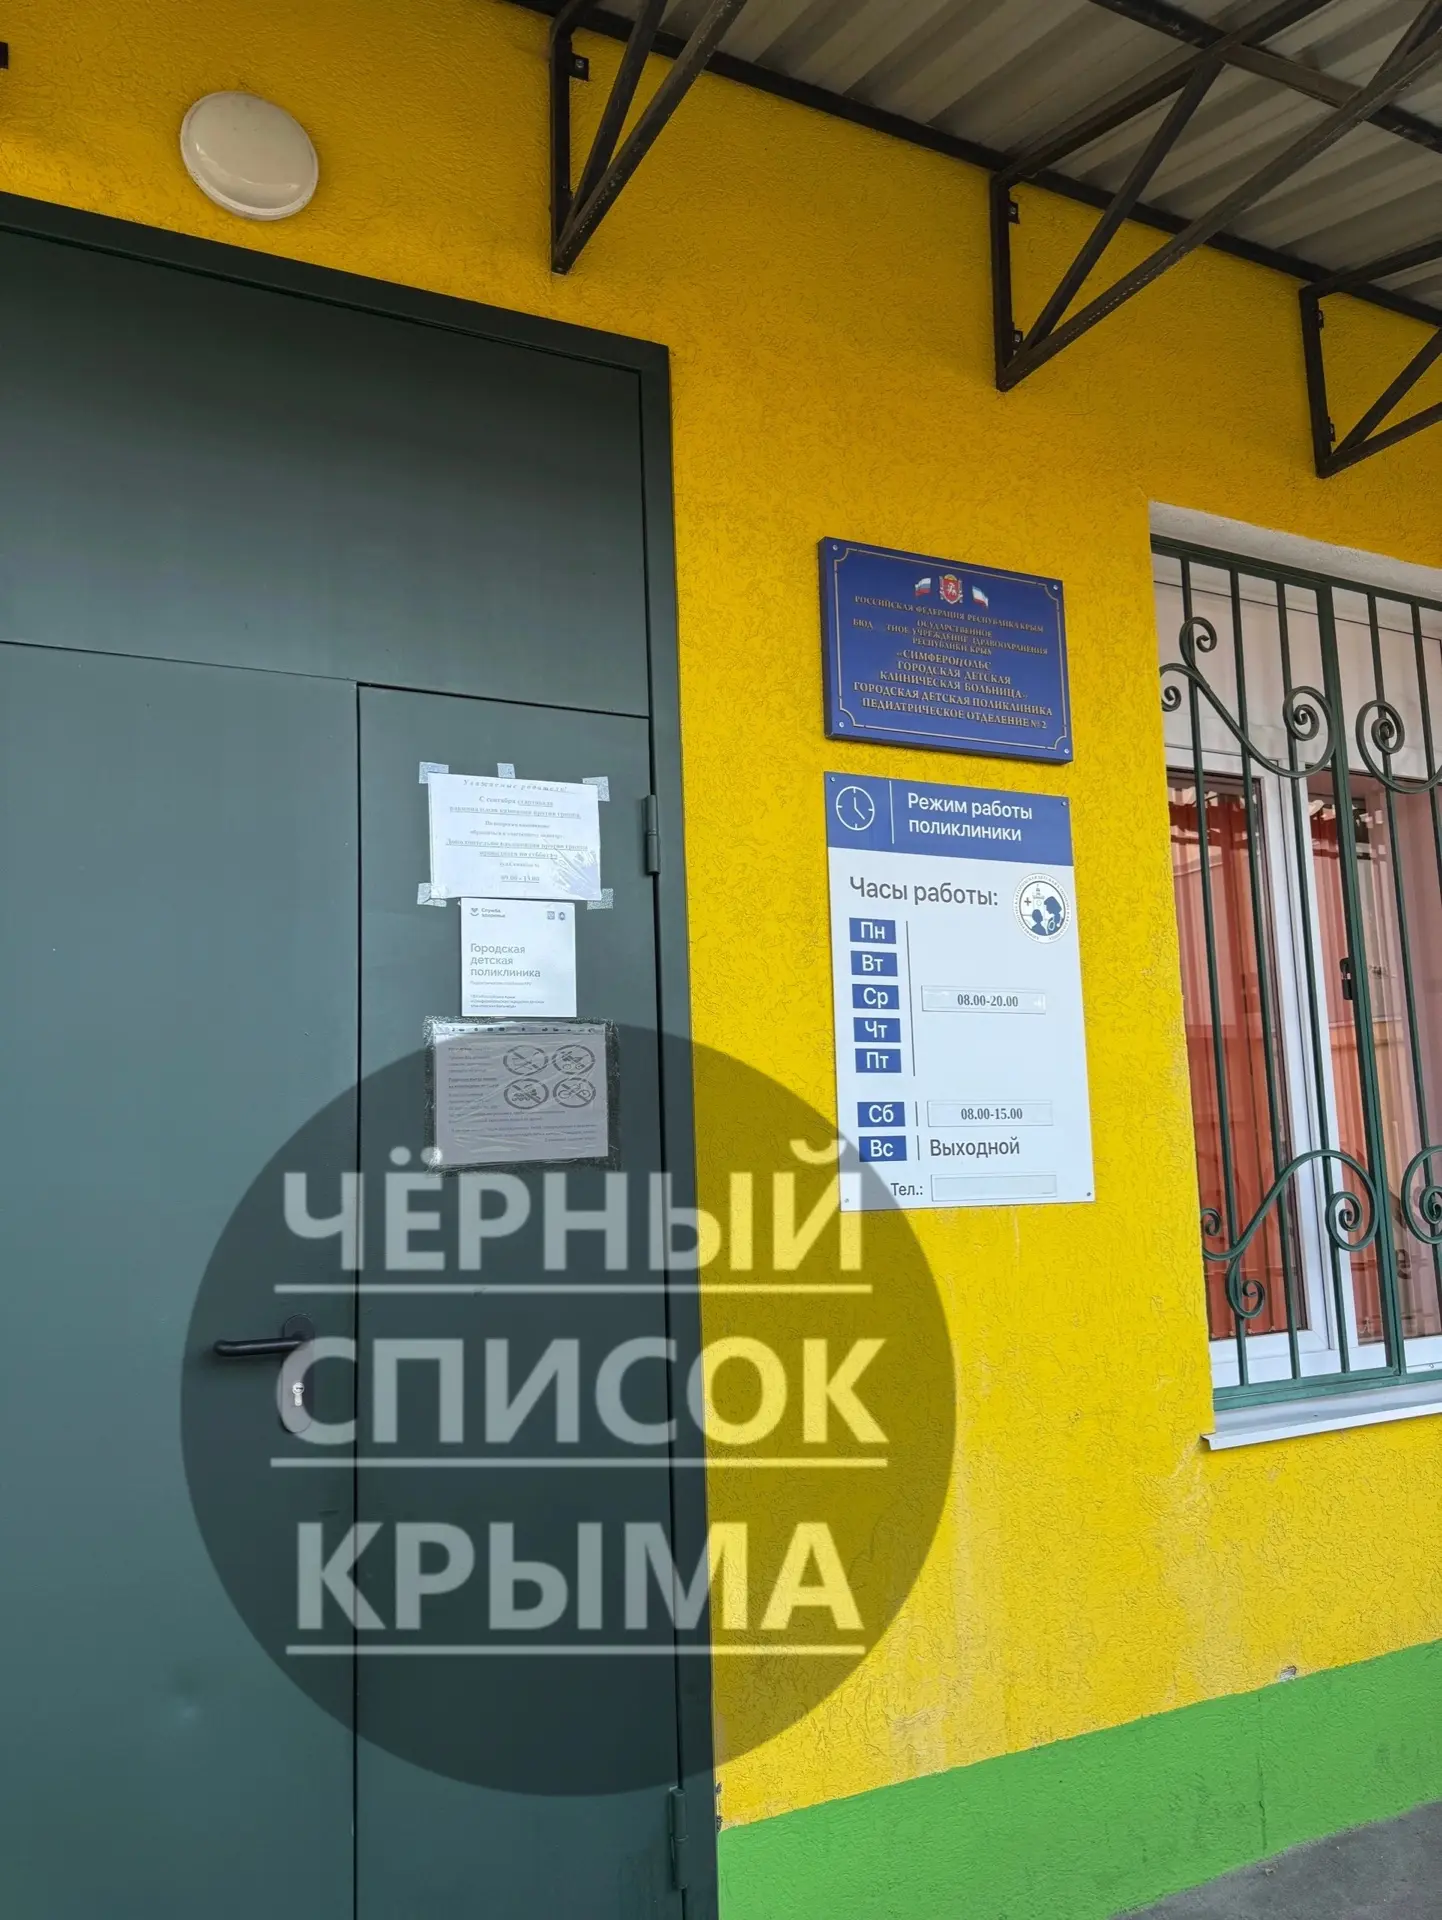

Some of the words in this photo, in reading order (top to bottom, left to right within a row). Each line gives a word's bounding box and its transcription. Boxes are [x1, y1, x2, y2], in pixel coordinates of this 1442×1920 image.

[855, 595, 914, 611] РОССИЙСКАЯ
[915, 604, 965, 619] ФЕДЕРАЦИЯ
[967, 613, 1019, 629] РЕСПУБЛИКА
[1020, 622, 1044, 633] КРЫМ
[880, 670, 961, 690] КЛИНИЧЕСКАЯ
[898, 660, 961, 678] ГОРОДСКАЯ
[964, 671, 1011, 685] ДЕТСКАЯ
[853, 681, 919, 698] ГОРОДСКАЯ
[921, 691, 970, 707] ДЕТСКАЯ
[972, 697, 1053, 716] ПОЛИКЛИНИКА
[862, 697, 965, 719] ПЕДИАТРИЧЕСКОЕ
[966, 711, 1030, 727] ОТДЕЛЕНИЕ
[907, 792, 967, 813] Режим
[971, 801, 1033, 820] работы
[909, 819, 1022, 842] поликлиники
[850, 876, 908, 901] Часы
[913, 882, 999, 906] работы:
[860, 921, 886, 940] Пн
[470, 943, 526, 955] Городская
[470, 956, 514, 966] детская
[862, 954, 884, 972] Вт
[470, 967, 541, 978] поликлиника
[863, 987, 889, 1009] Ср
[957, 994, 1019, 1008] 08.00-20.00
[865, 1020, 888, 1039] Чт
[866, 1052, 889, 1069] Пт
[868, 1104, 894, 1123] Сб
[960, 1108, 1023, 1120] 08.00-15.00
[870, 1139, 894, 1158] Вс
[929, 1136, 1020, 1158] Выходной
[890, 1182, 924, 1197] Тел.:
